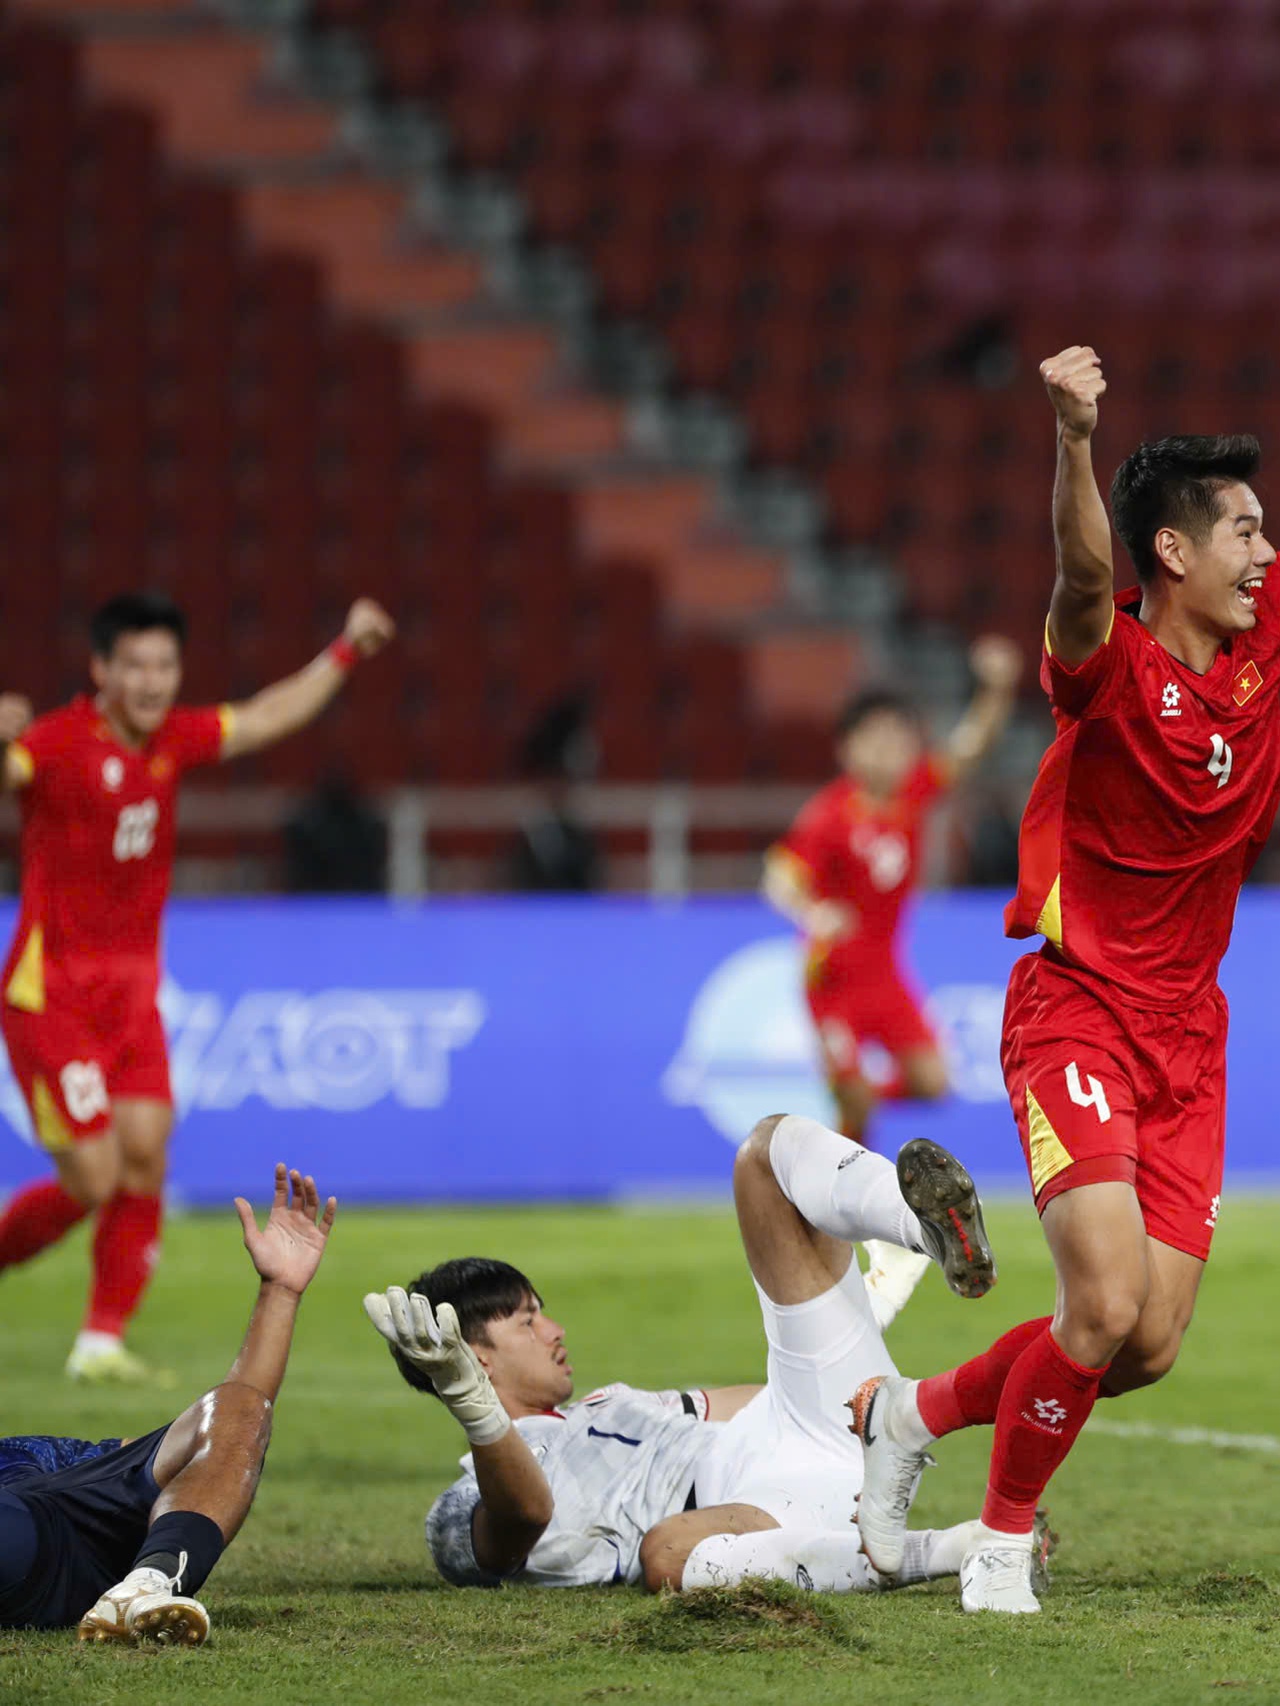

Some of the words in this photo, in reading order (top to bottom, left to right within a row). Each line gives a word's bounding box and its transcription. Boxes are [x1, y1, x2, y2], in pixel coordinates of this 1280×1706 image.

[1207, 733, 1232, 789] 4
[197, 989, 485, 1112] AOT
[1064, 1061, 1112, 1124] 4
